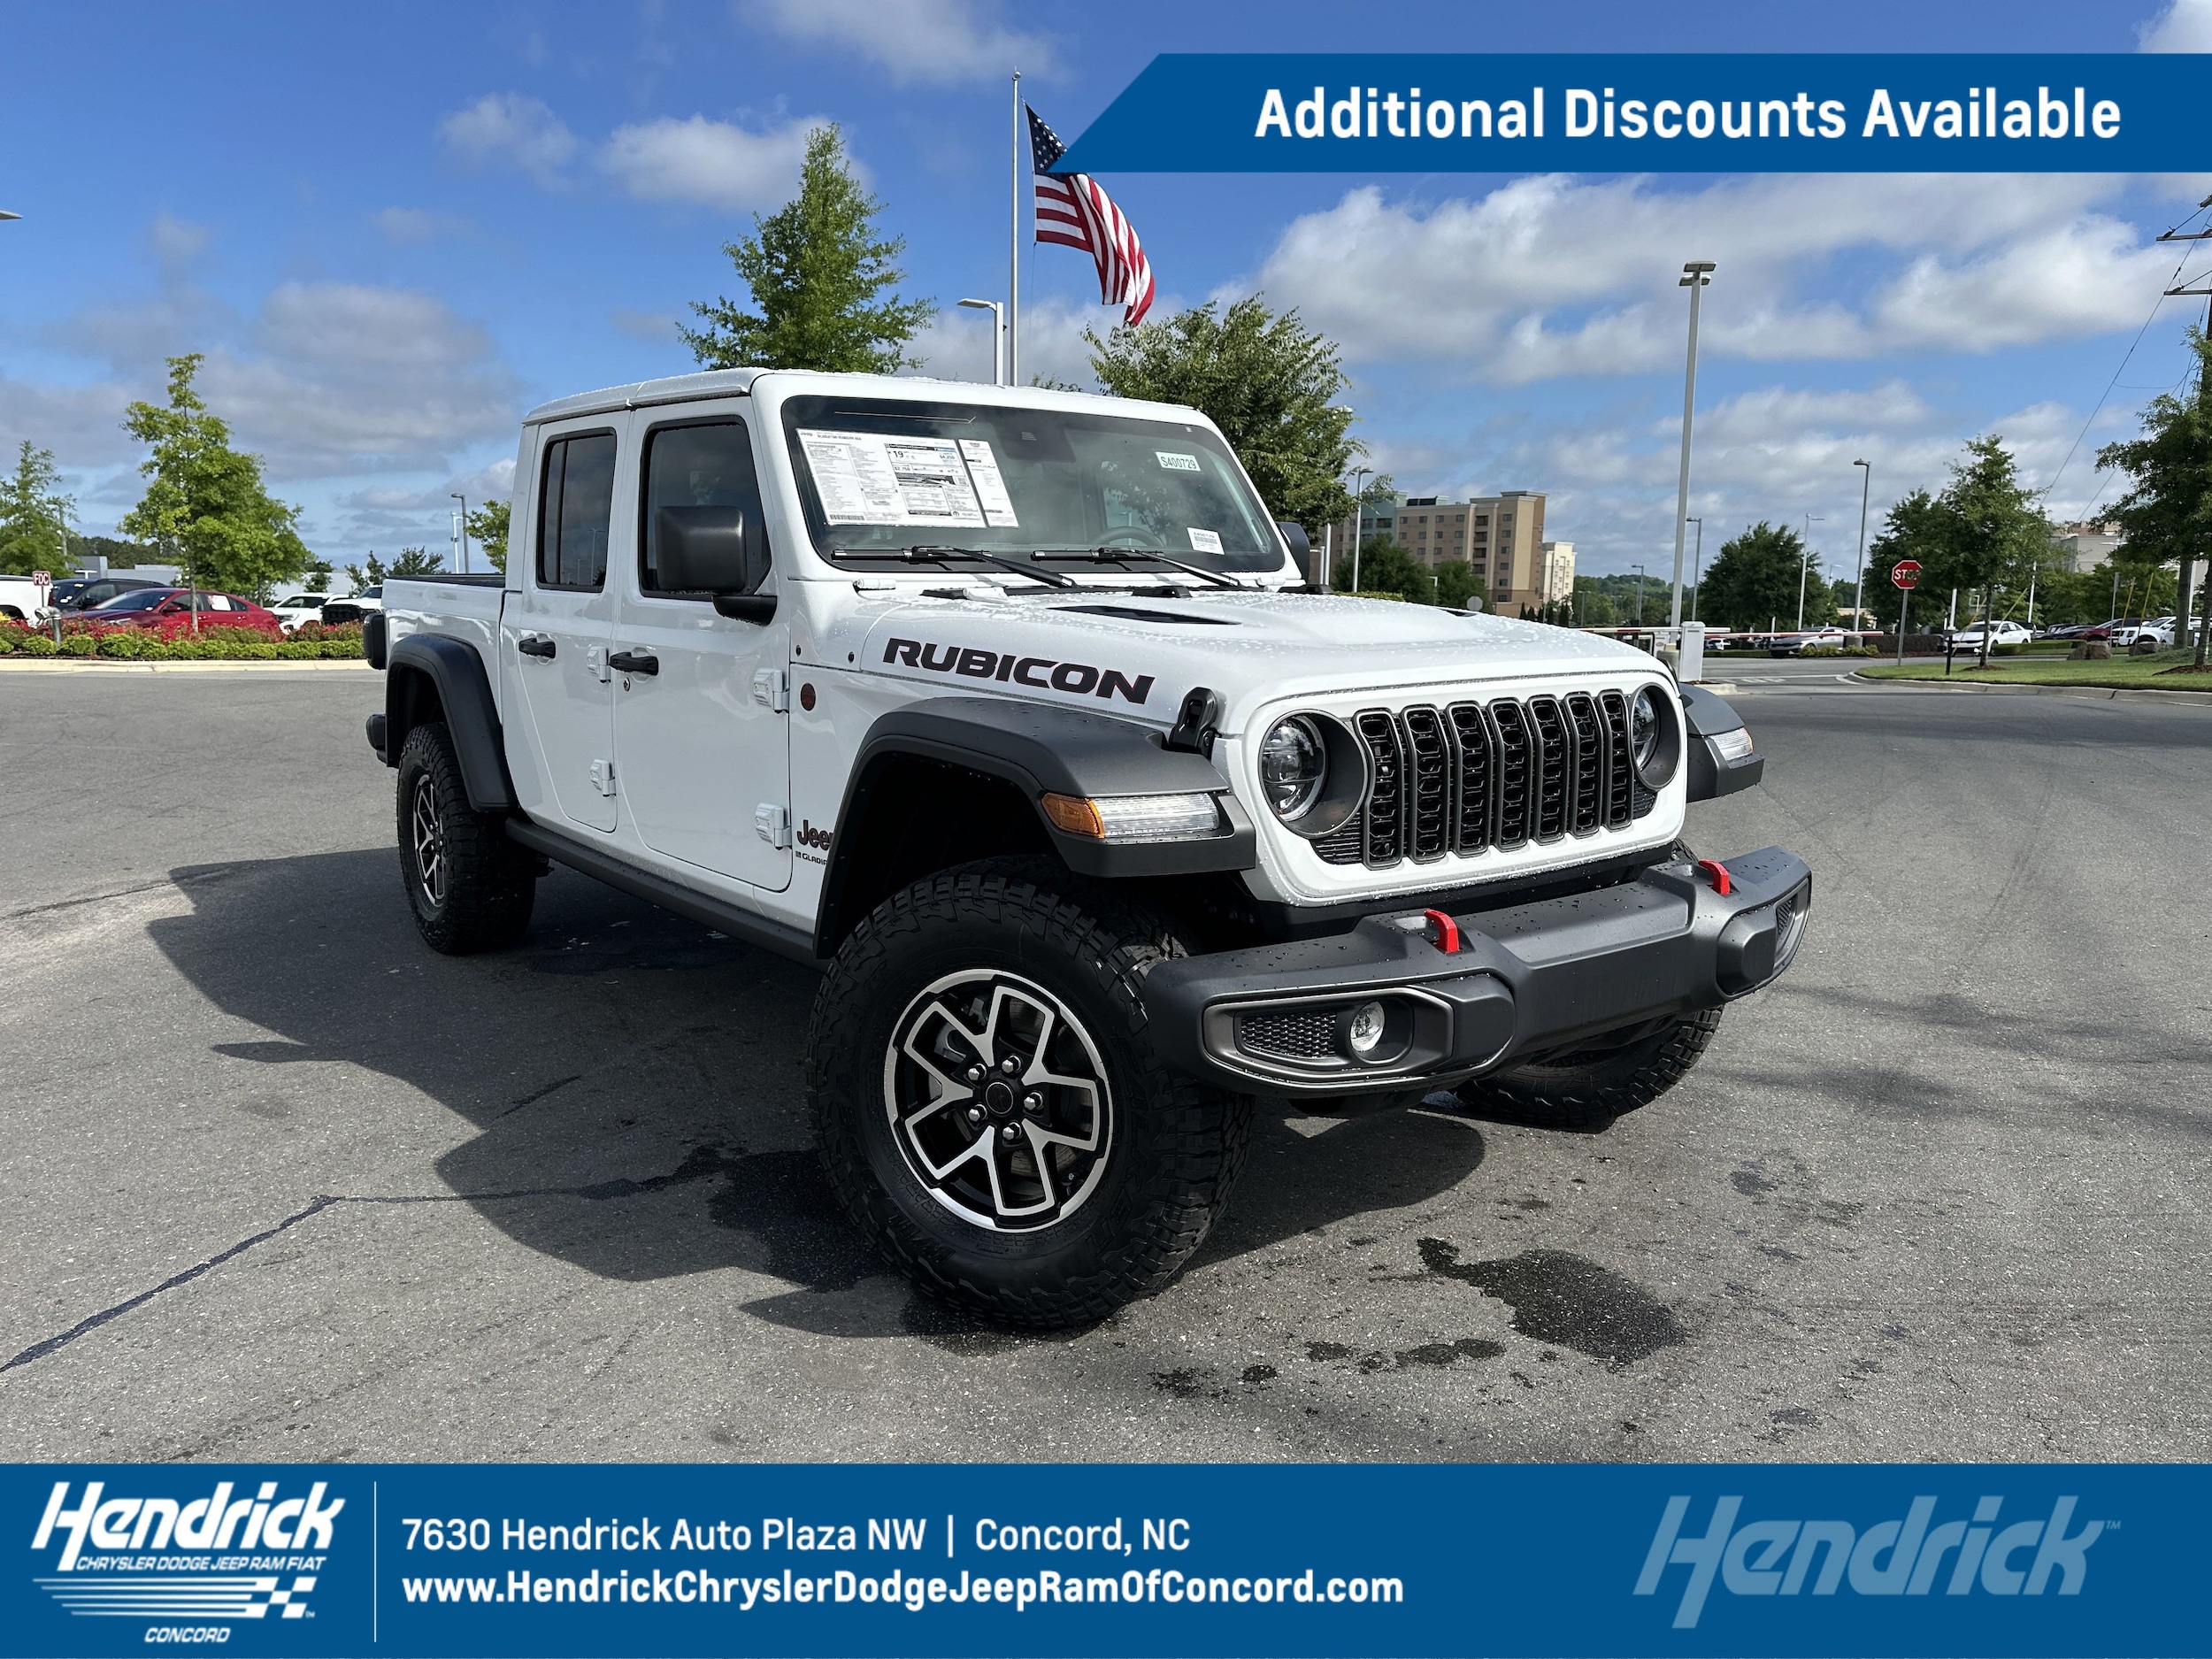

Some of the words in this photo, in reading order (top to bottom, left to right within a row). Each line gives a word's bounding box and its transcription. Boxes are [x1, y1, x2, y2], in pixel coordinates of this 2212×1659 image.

[1161, 457, 1197, 469] S400729
[34, 572, 49, 585] FDC
[882, 638, 1156, 705] RUBICON
